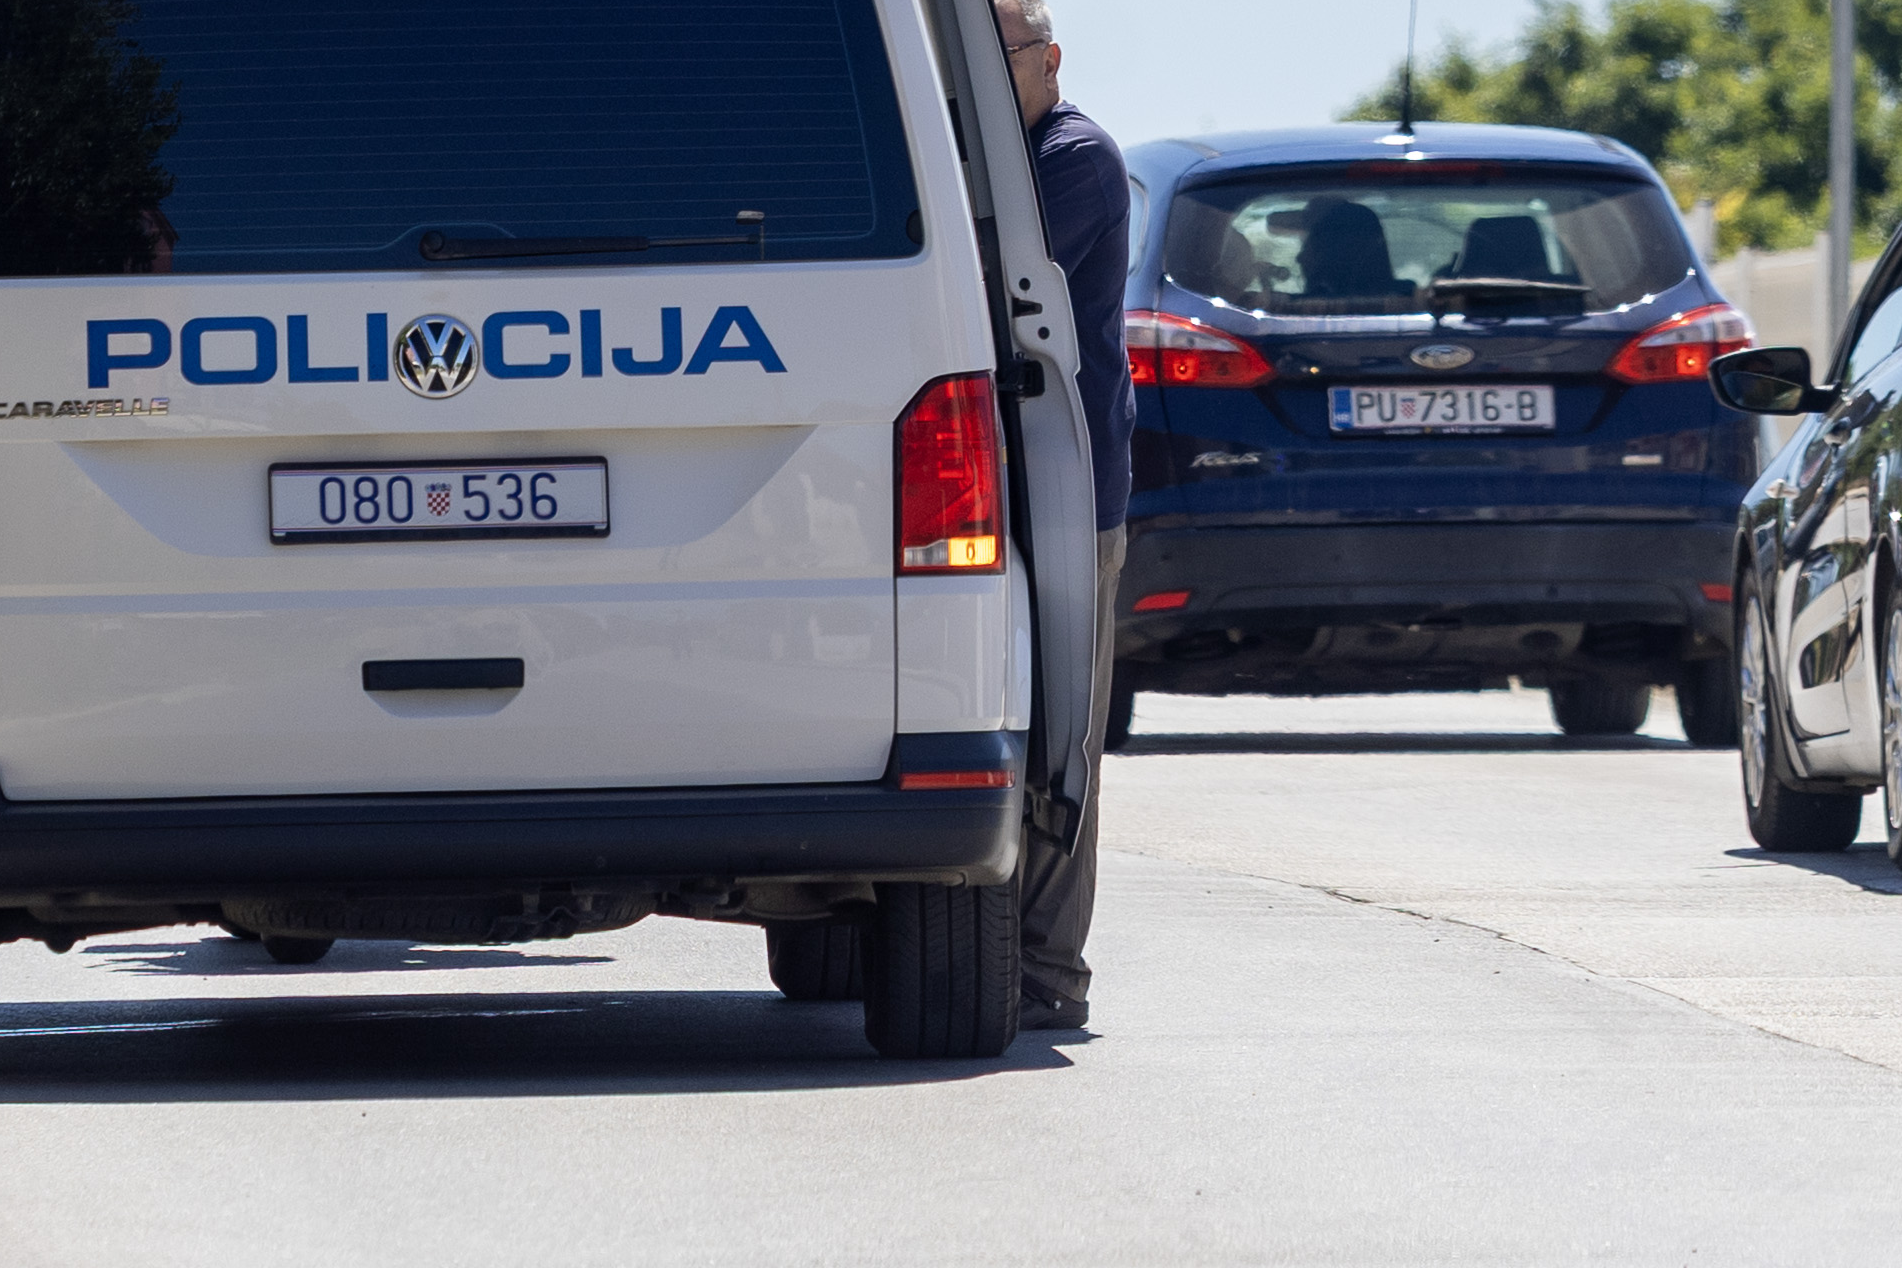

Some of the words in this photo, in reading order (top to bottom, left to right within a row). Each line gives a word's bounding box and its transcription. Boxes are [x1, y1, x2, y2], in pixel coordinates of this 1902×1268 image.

[394, 314, 479, 399] VW
[1355, 390, 1397, 424] PU
[1418, 390, 1538, 422] 7316-B
[318, 475, 414, 525] 080
[461, 472, 558, 522] 536
